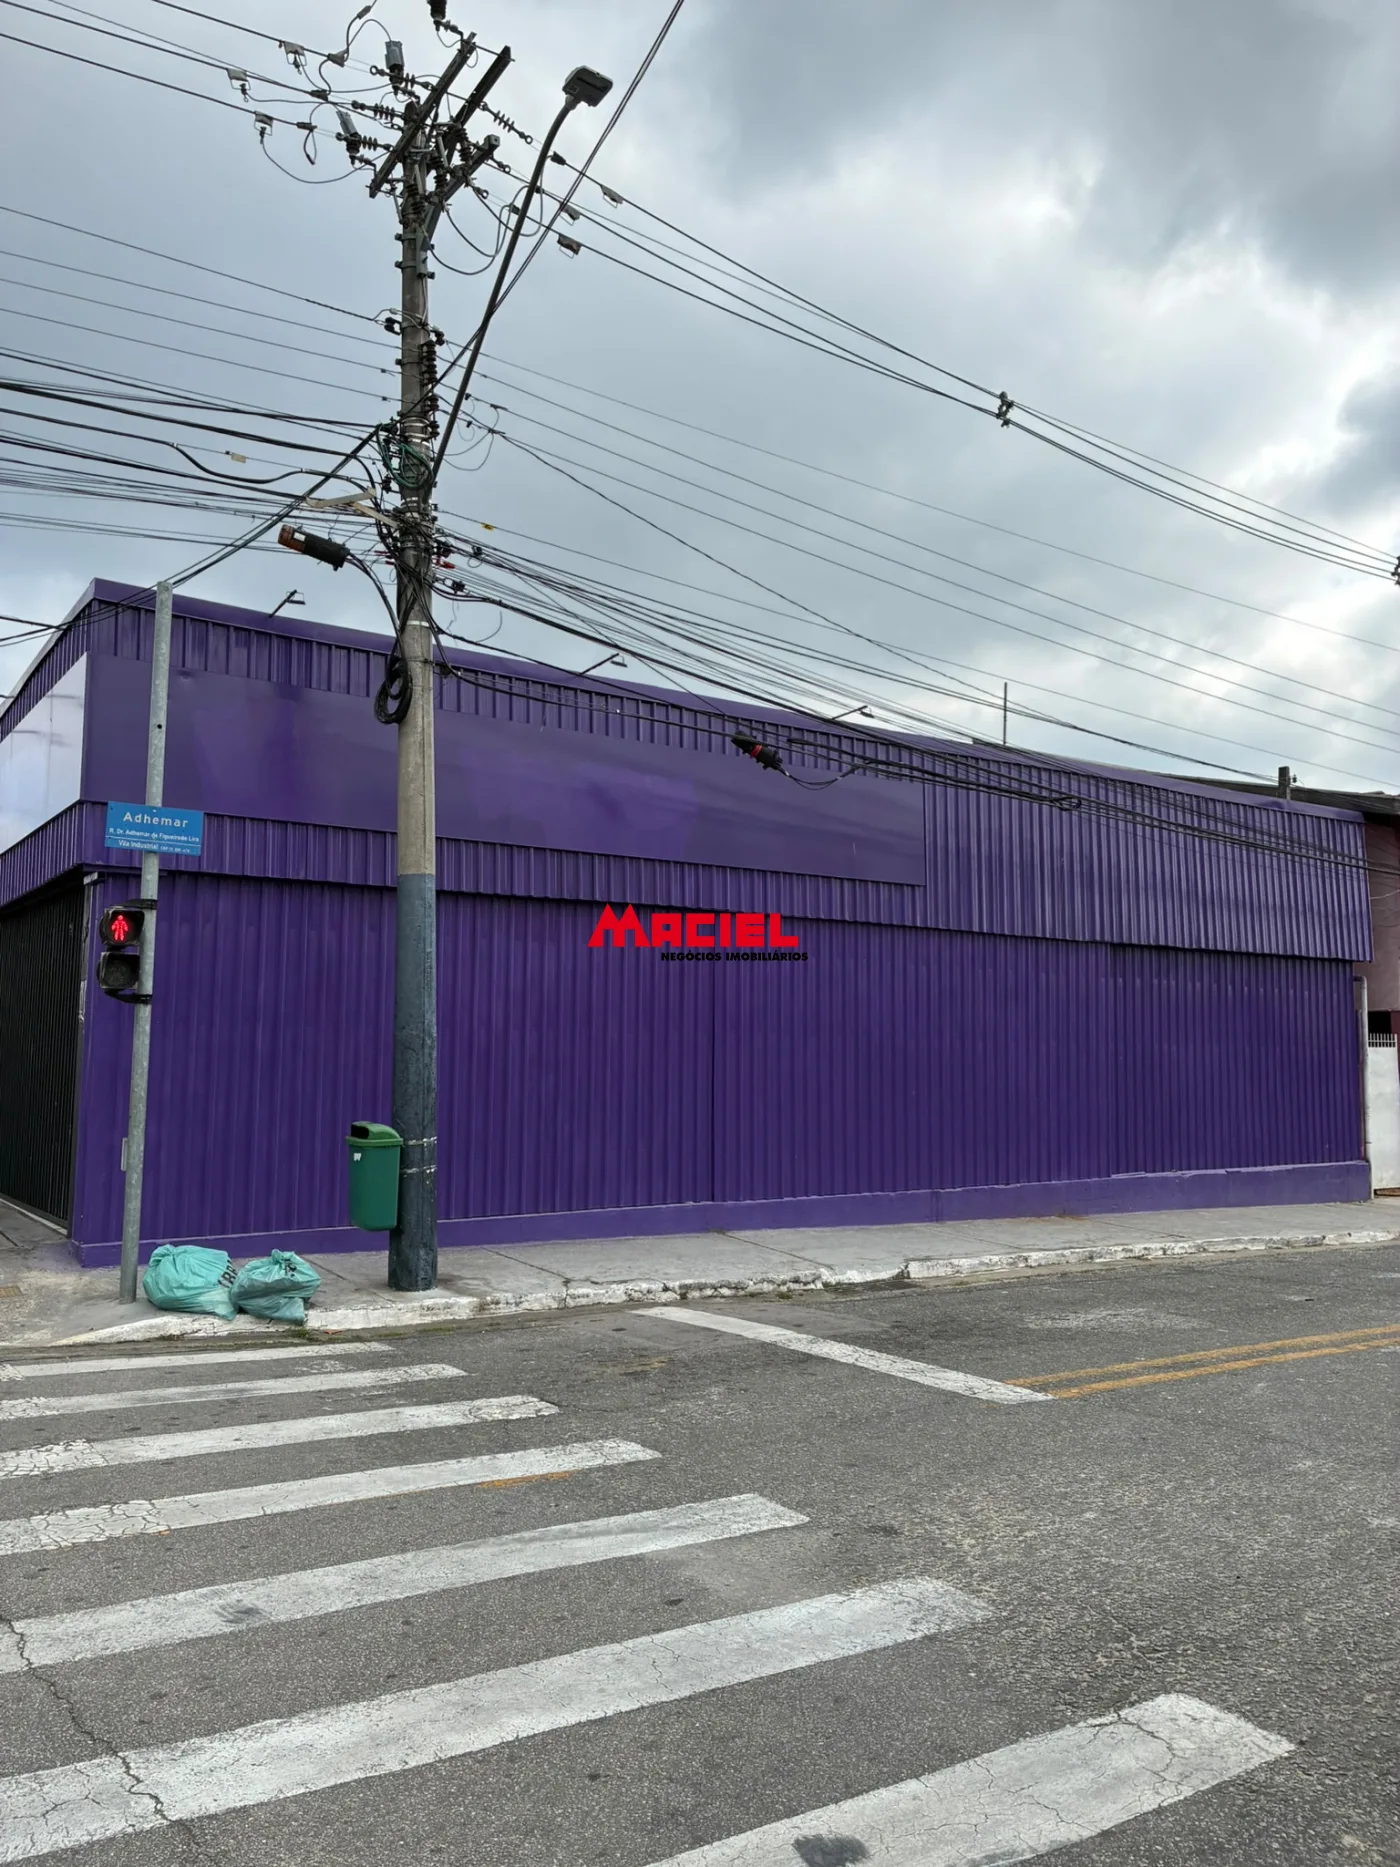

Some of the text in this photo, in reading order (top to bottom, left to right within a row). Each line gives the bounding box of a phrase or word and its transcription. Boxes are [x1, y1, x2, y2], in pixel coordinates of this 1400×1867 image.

[123, 812, 189, 828] Adhemar
[125, 829, 150, 838] Adhemar
[118, 839, 129, 847] Vila
[131, 841, 159, 850] Industrial
